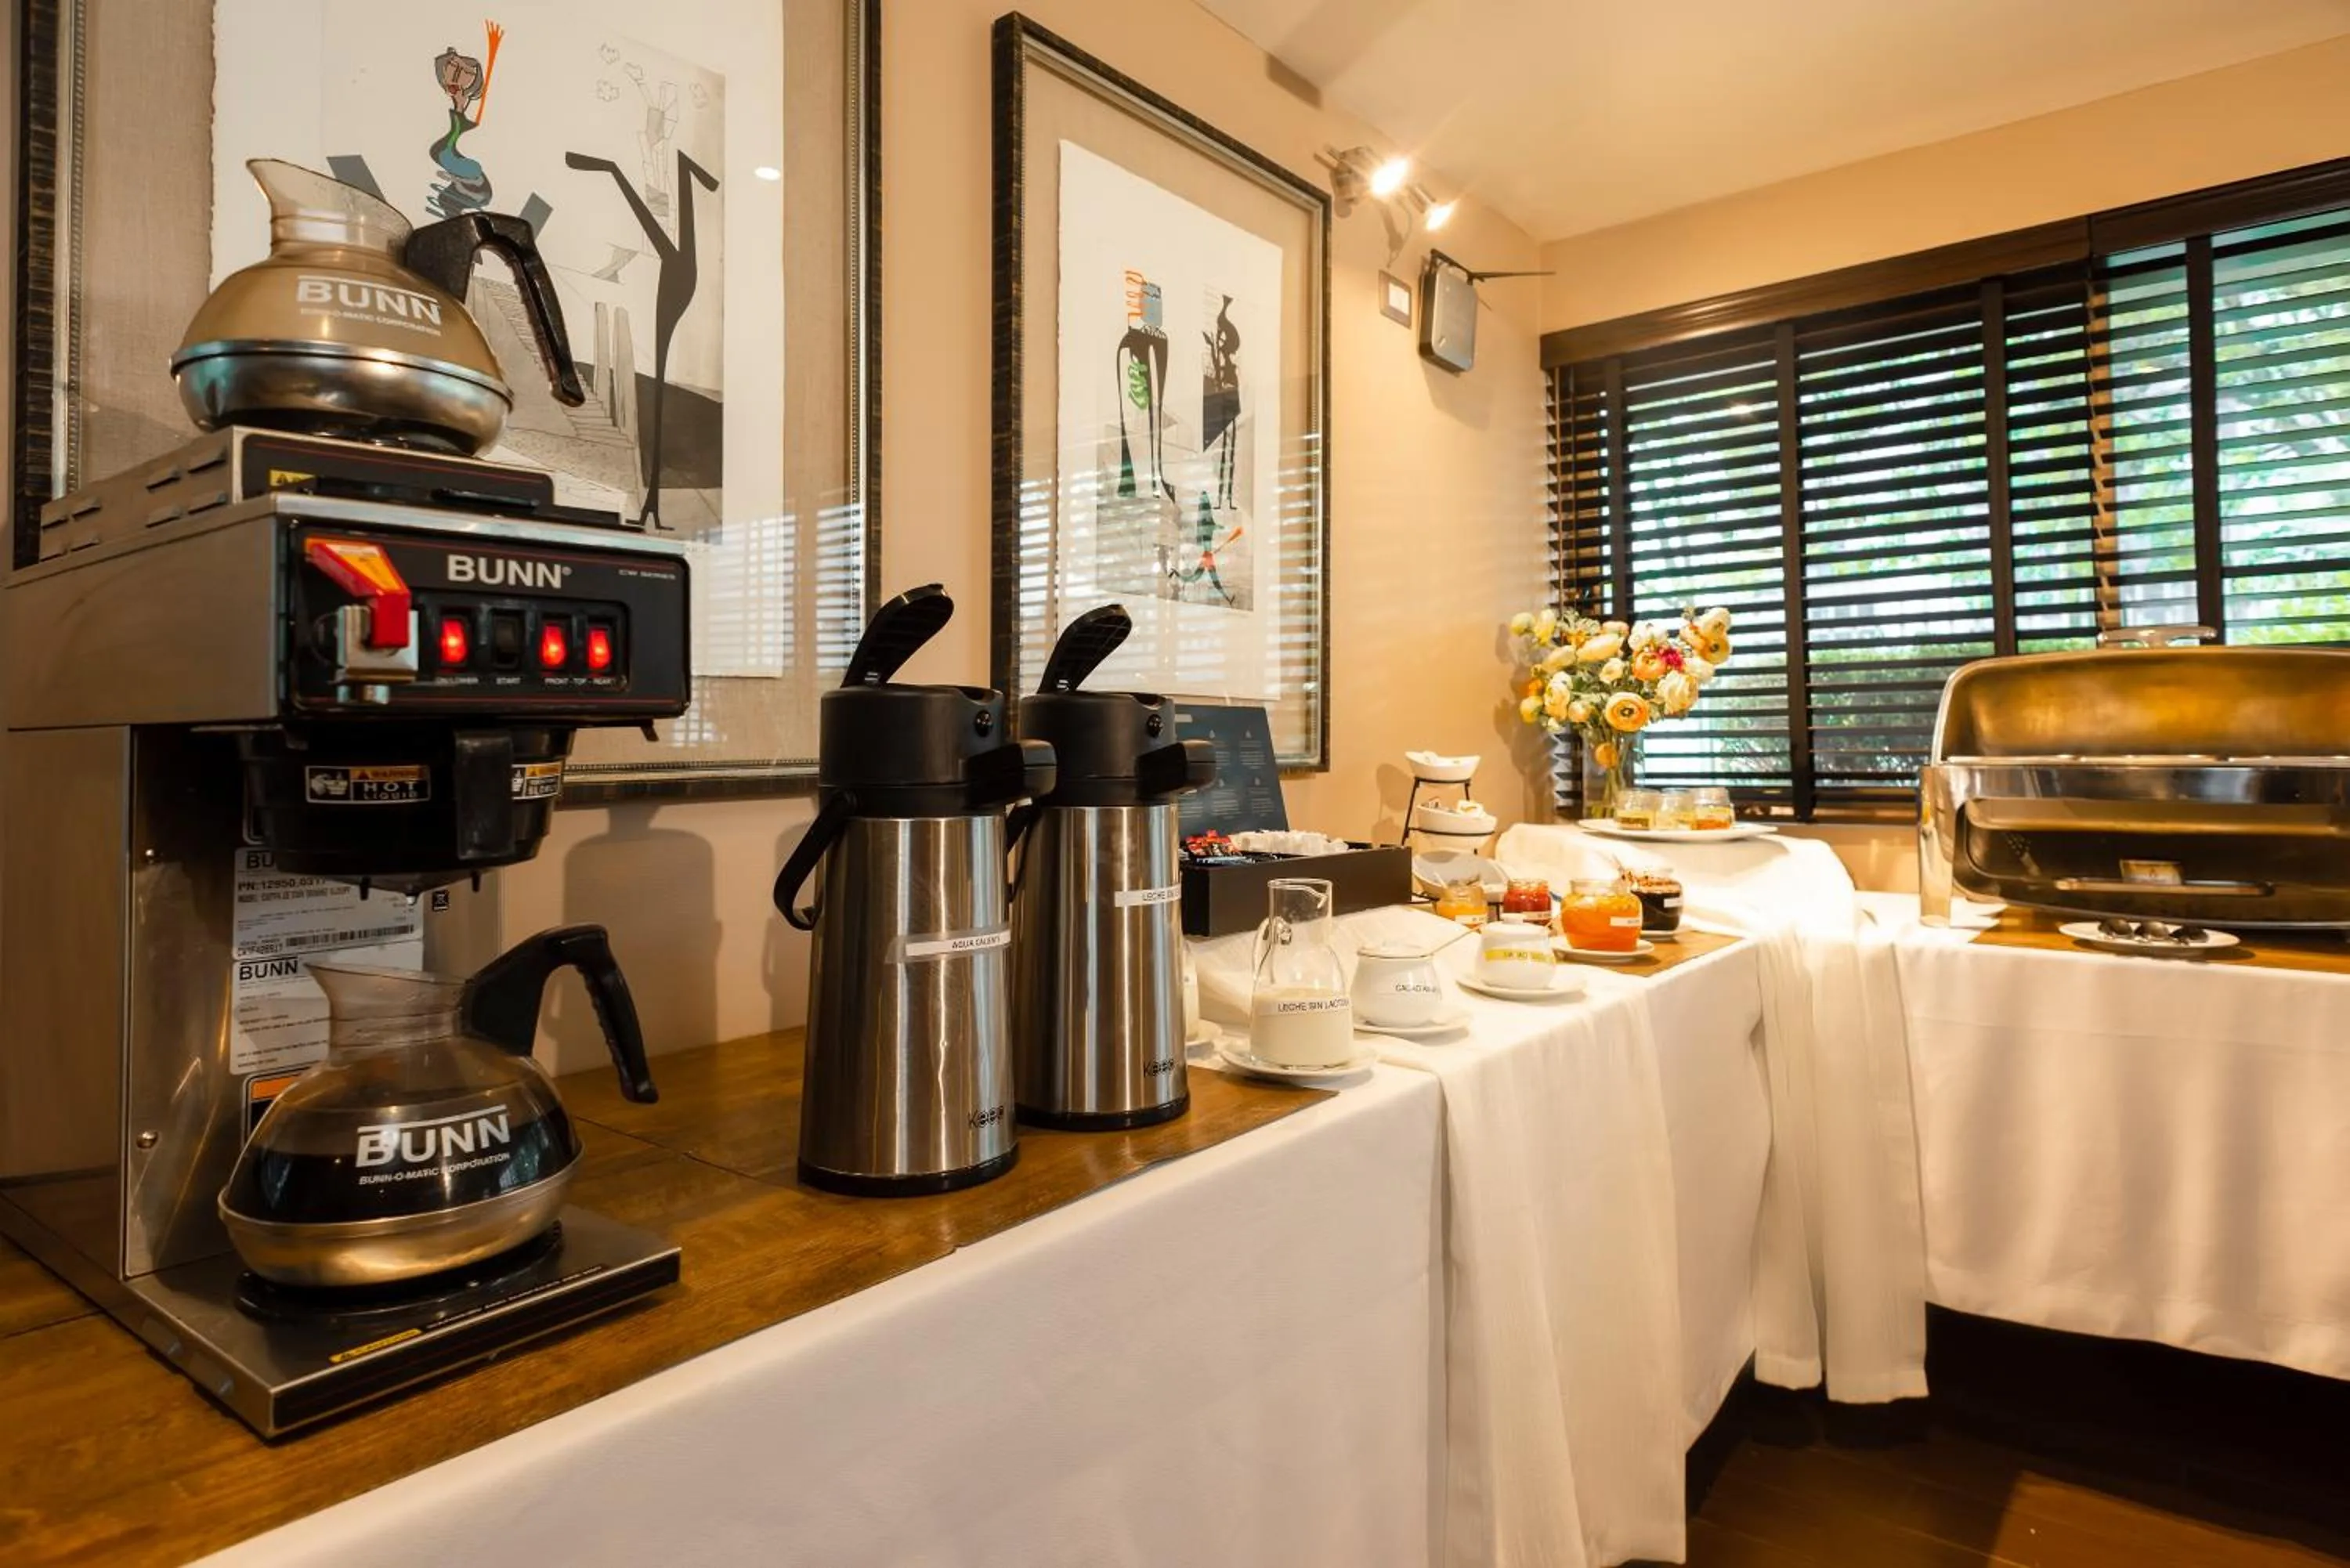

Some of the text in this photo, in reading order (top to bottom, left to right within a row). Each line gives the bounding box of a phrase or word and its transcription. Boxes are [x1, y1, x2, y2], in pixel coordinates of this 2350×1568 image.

[298, 280, 441, 326] BUNN
[363, 782, 417, 793] HOT
[246, 850, 274, 869] BU
[239, 959, 298, 981] BUNN
[1278, 1003, 1307, 1013] LECHE
[356, 1114, 510, 1168] BUNN
[359, 1167, 439, 1185] BUNN-O-MATIC
